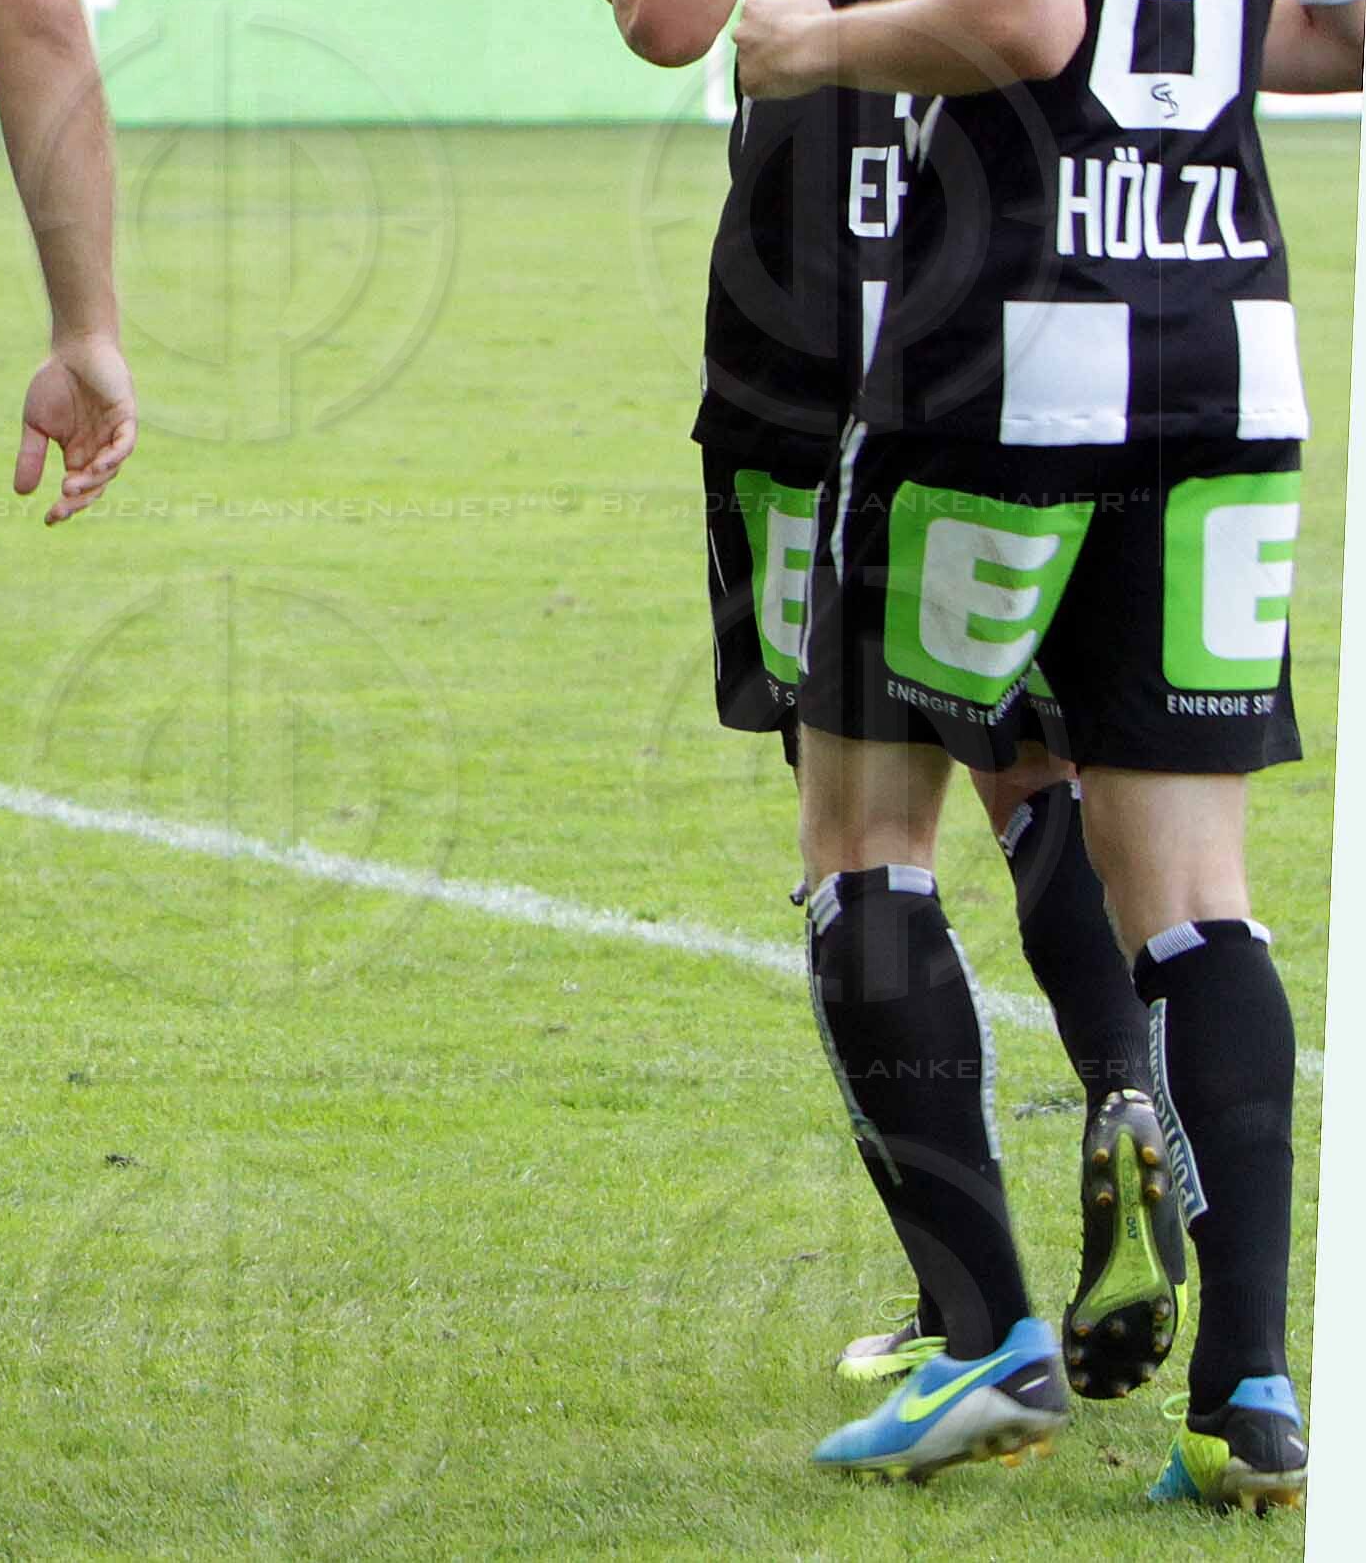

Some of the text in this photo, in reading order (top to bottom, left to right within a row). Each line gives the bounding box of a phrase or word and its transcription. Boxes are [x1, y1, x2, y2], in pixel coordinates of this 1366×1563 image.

[1056, 145, 1268, 261] HÖLZL
[918, 517, 1061, 678] E
[887, 679, 960, 719] ENERGIE
[1167, 693, 1244, 717] ENERGIE
